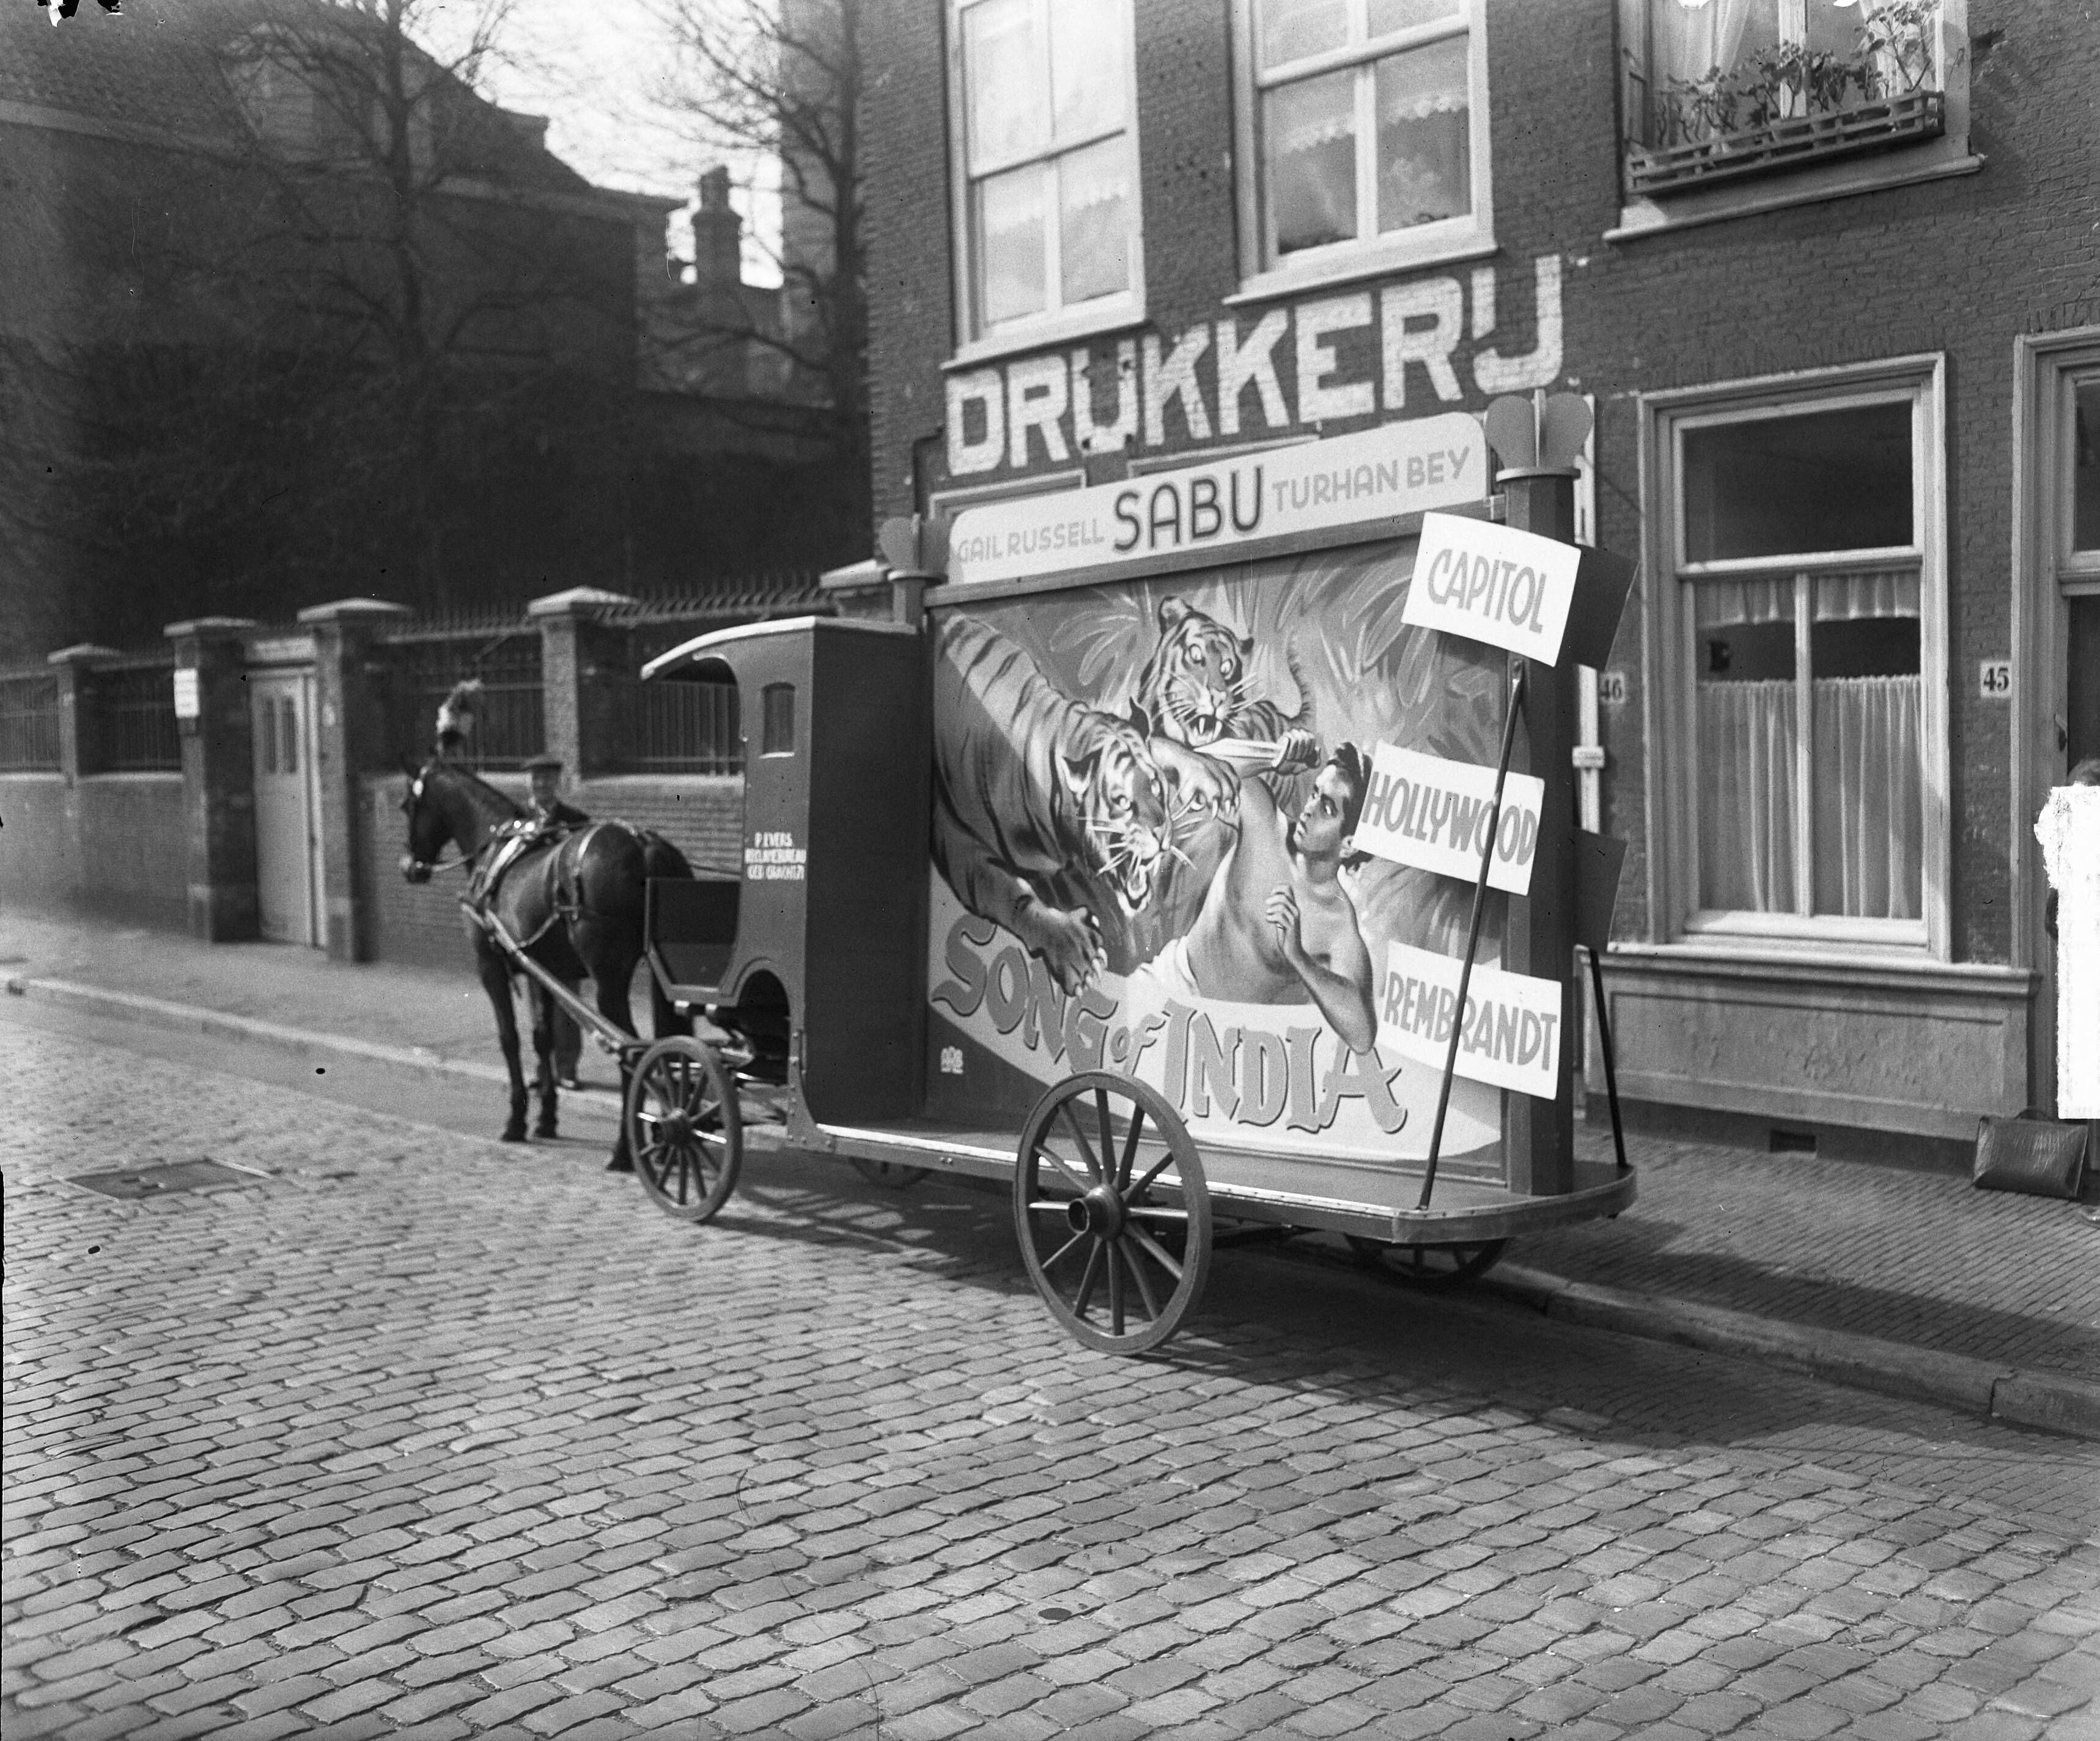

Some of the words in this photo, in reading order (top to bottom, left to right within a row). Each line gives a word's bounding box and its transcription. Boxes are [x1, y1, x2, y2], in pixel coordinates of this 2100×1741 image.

[945, 254, 1563, 476] DRUKKERIJ
[958, 536, 1003, 563] GAIL
[1008, 518, 1104, 557] RUSSELL
[1114, 464, 1264, 552] SABU
[1272, 460, 1399, 512] TURHAN
[1407, 446, 1470, 489] BEY
[1428, 549, 1547, 634] CAPITOL
[1983, 666, 2010, 693] 45
[1361, 771, 1538, 866] HOLLYWOOD
[932, 913, 1119, 1075] SONG
[1110, 1013, 1166, 1077] of
[1162, 997, 1408, 1135] INDIA
[1383, 971, 1558, 1072] REMBRANDT
